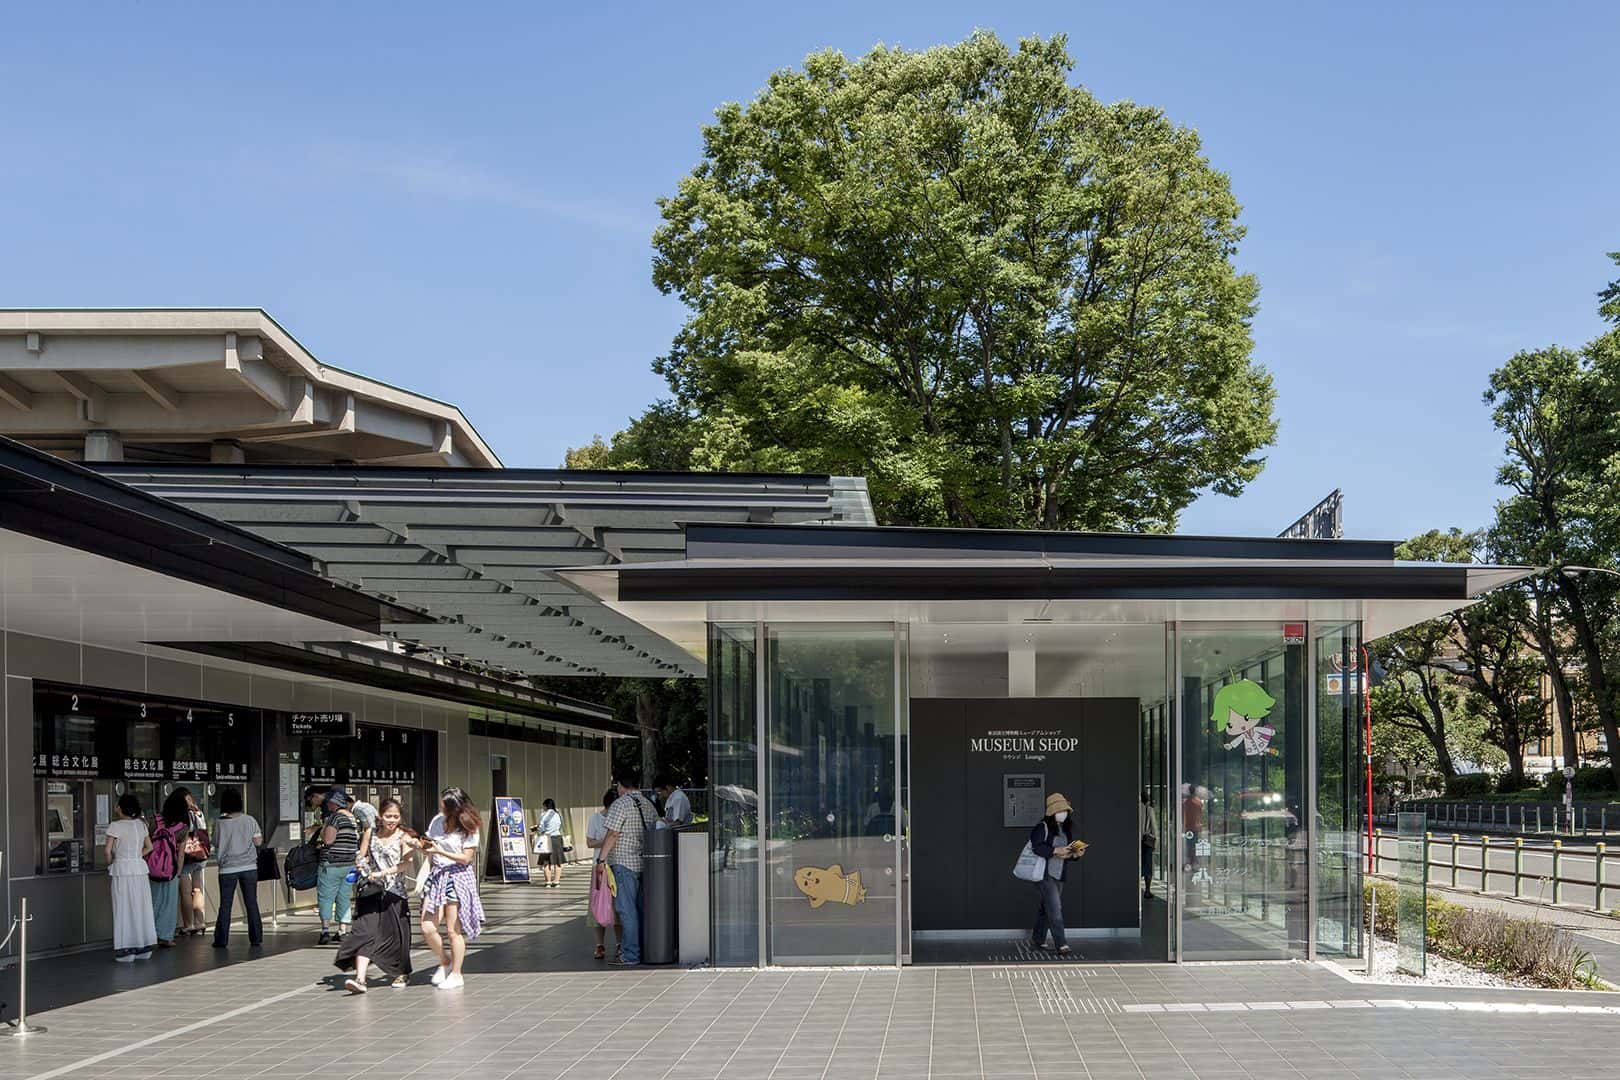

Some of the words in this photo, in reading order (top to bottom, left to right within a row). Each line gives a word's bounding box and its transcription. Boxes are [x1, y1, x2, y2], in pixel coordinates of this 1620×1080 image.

[72, 694, 79, 711] 2
[140, 703, 147, 718] 3
[186, 708, 193, 724] 4
[228, 713, 234, 727] 5
[971, 738, 1034, 752] MUSEUM
[1039, 738, 1078, 752] SHOP
